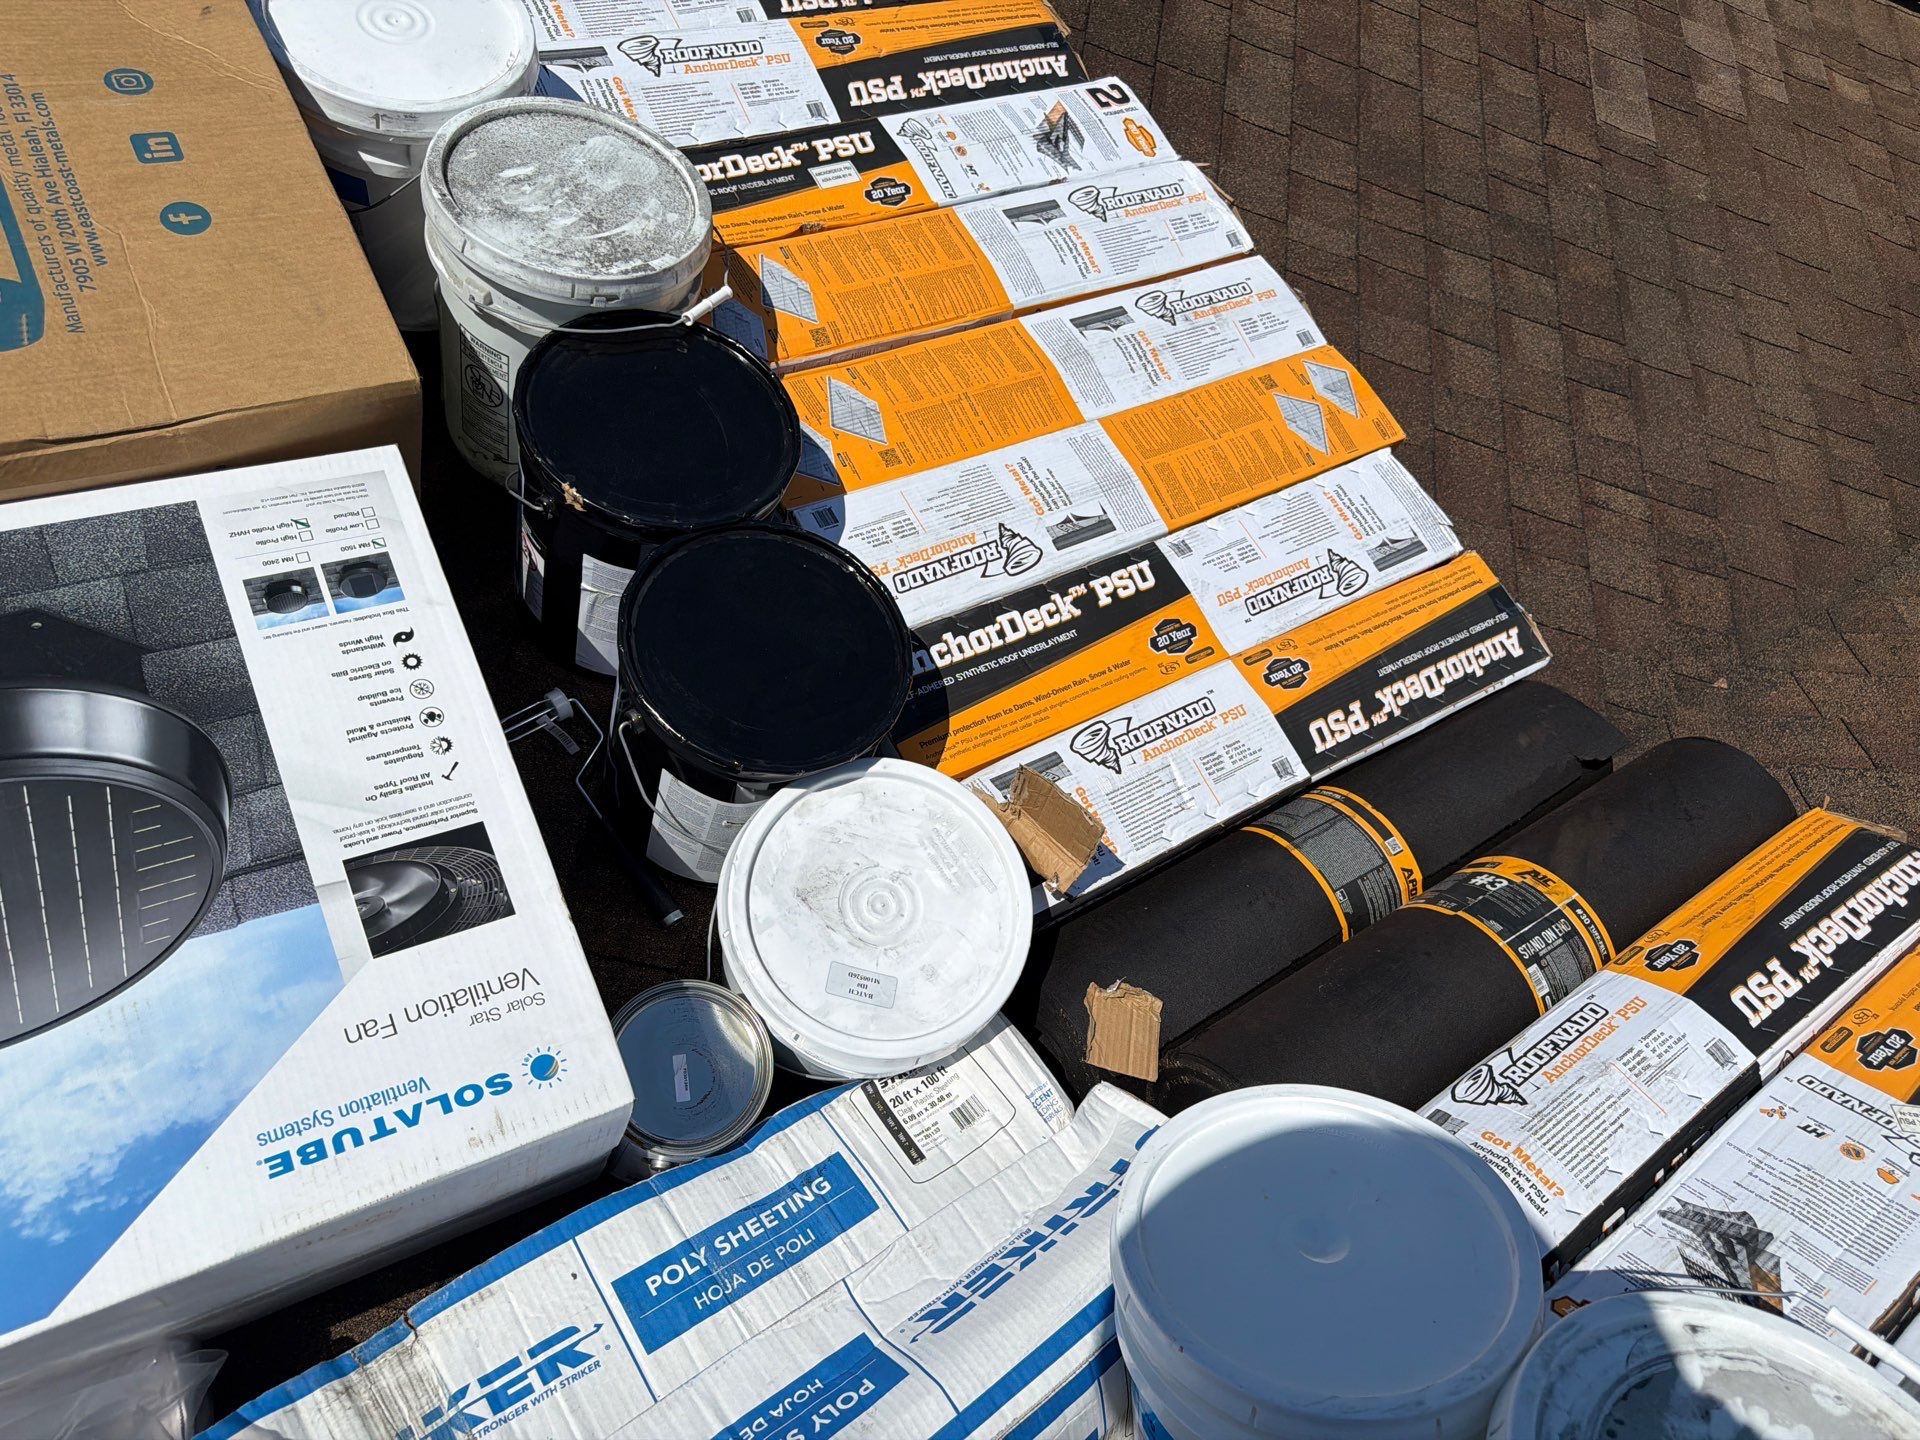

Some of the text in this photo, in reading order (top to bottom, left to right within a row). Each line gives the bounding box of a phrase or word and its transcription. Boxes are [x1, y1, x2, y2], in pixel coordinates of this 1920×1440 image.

[764, 52, 791, 65] PSU
[0, 73, 28, 109] 33014
[847, 74, 908, 107] PSU
[19, 125, 54, 179] Hialeah,
[810, 130, 875, 162] PSU
[30, 91, 108, 267] www.eastcoast-metals.com
[43, 180, 64, 205] Ave
[0, 128, 86, 334] Manufacturers of quality metal
[48, 207, 76, 238] 20th
[60, 240, 82, 256] W
[67, 257, 97, 293] 7905
[348, 521, 365, 529] Low
[1090, 559, 1156, 607] PSU
[1216, 586, 1242, 607] PSU
[337, 633, 383, 648] High Winds
[340, 641, 386, 655] Withstands
[1155, 626, 1192, 648] 20 Year
[1376, 611, 1509, 677] SELF-ADHERED SYNTHETIC ROOF UNDERLAYMENT
[330, 659, 392, 678] on Electric Bills
[954, 628, 1078, 681] SYNTHETIC ROOF UNDERLAYMENT
[347, 667, 395, 682] Solar Saves
[1268, 662, 1304, 683] 20 Year
[356, 686, 402, 702] Ice Buildup
[368, 694, 405, 707] Prevents
[917, 658, 1131, 753] Premium protection from Ice Dams, Wind-Driven Rain, Snow & Water
[375, 714, 412, 727] Moisture
[1219, 703, 1247, 725] PSU
[1308, 699, 1370, 754] PSU
[345, 725, 367, 736] Mold
[347, 722, 414, 744] Protects Against
[365, 743, 422, 761] Temperatures
[383, 750, 424, 766] Regulates
[364, 779, 434, 802] Installs Easily On
[373, 771, 430, 791] All Roof Types
[1575, 908, 1591, 925] #30
[1517, 918, 1571, 959] STAND ON END
[343, 967, 541, 1044] Ventilation Fan
[847, 987, 874, 1000] BATCH
[1615, 995, 1648, 1021] PSU
[1729, 956, 1803, 1028] PSU
[468, 991, 546, 1027] Solar Star
[1867, 1033, 1906, 1066] 20 Year
[888, 1061, 948, 1109] 20 ft x 100 ft
[256, 1076, 431, 1147] Ventilation Systems
[901, 1113, 917, 1125] 6.09
[915, 1109, 924, 1118] m
[944, 1091, 952, 1099] m
[1480, 1131, 1565, 1197] Got Metal?
[1510, 1177, 1525, 1194] the
[1524, 1192, 1549, 1217] heat!
[1528, 1183, 1550, 1204] PSU
[644, 1176, 832, 1296] POLY SHEETING
[693, 1227, 816, 1310] HOJA DE POLI
[903, 1224, 1037, 1325] BUILD STRONGER WITH STRIKER
[529, 1384, 558, 1407] WITH
[558, 1359, 601, 1390] STRIKER
[738, 1377, 824, 1440] HOJA DE
[810, 1377, 876, 1430] POLY
